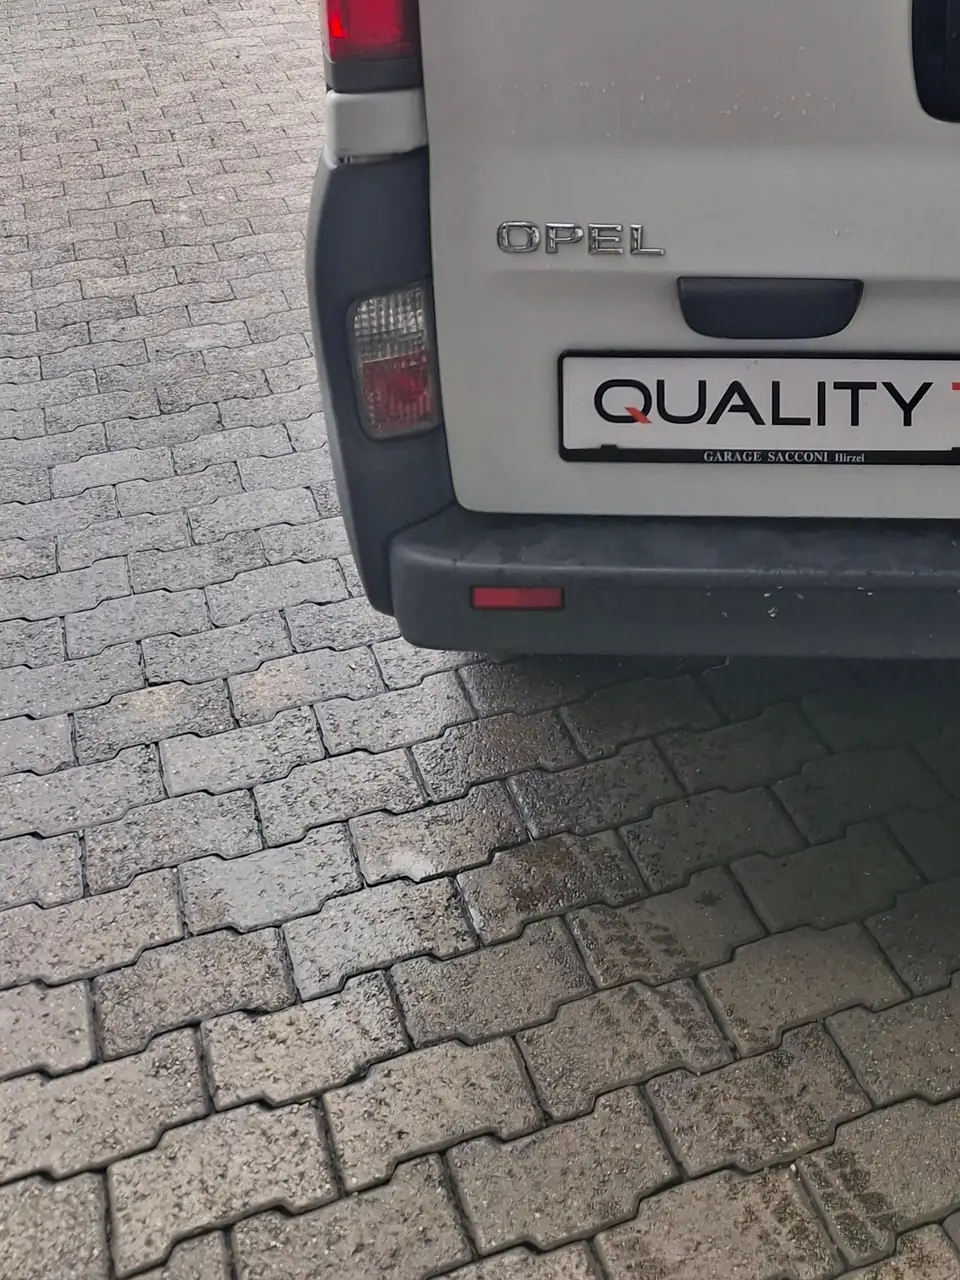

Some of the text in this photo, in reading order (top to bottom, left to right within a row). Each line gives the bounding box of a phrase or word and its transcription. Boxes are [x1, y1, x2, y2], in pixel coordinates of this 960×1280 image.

[496, 221, 666, 256] OPEL
[593, 378, 934, 427] QUALITY
[703, 450, 865, 464] GARAGE SACCONI Hirzel
